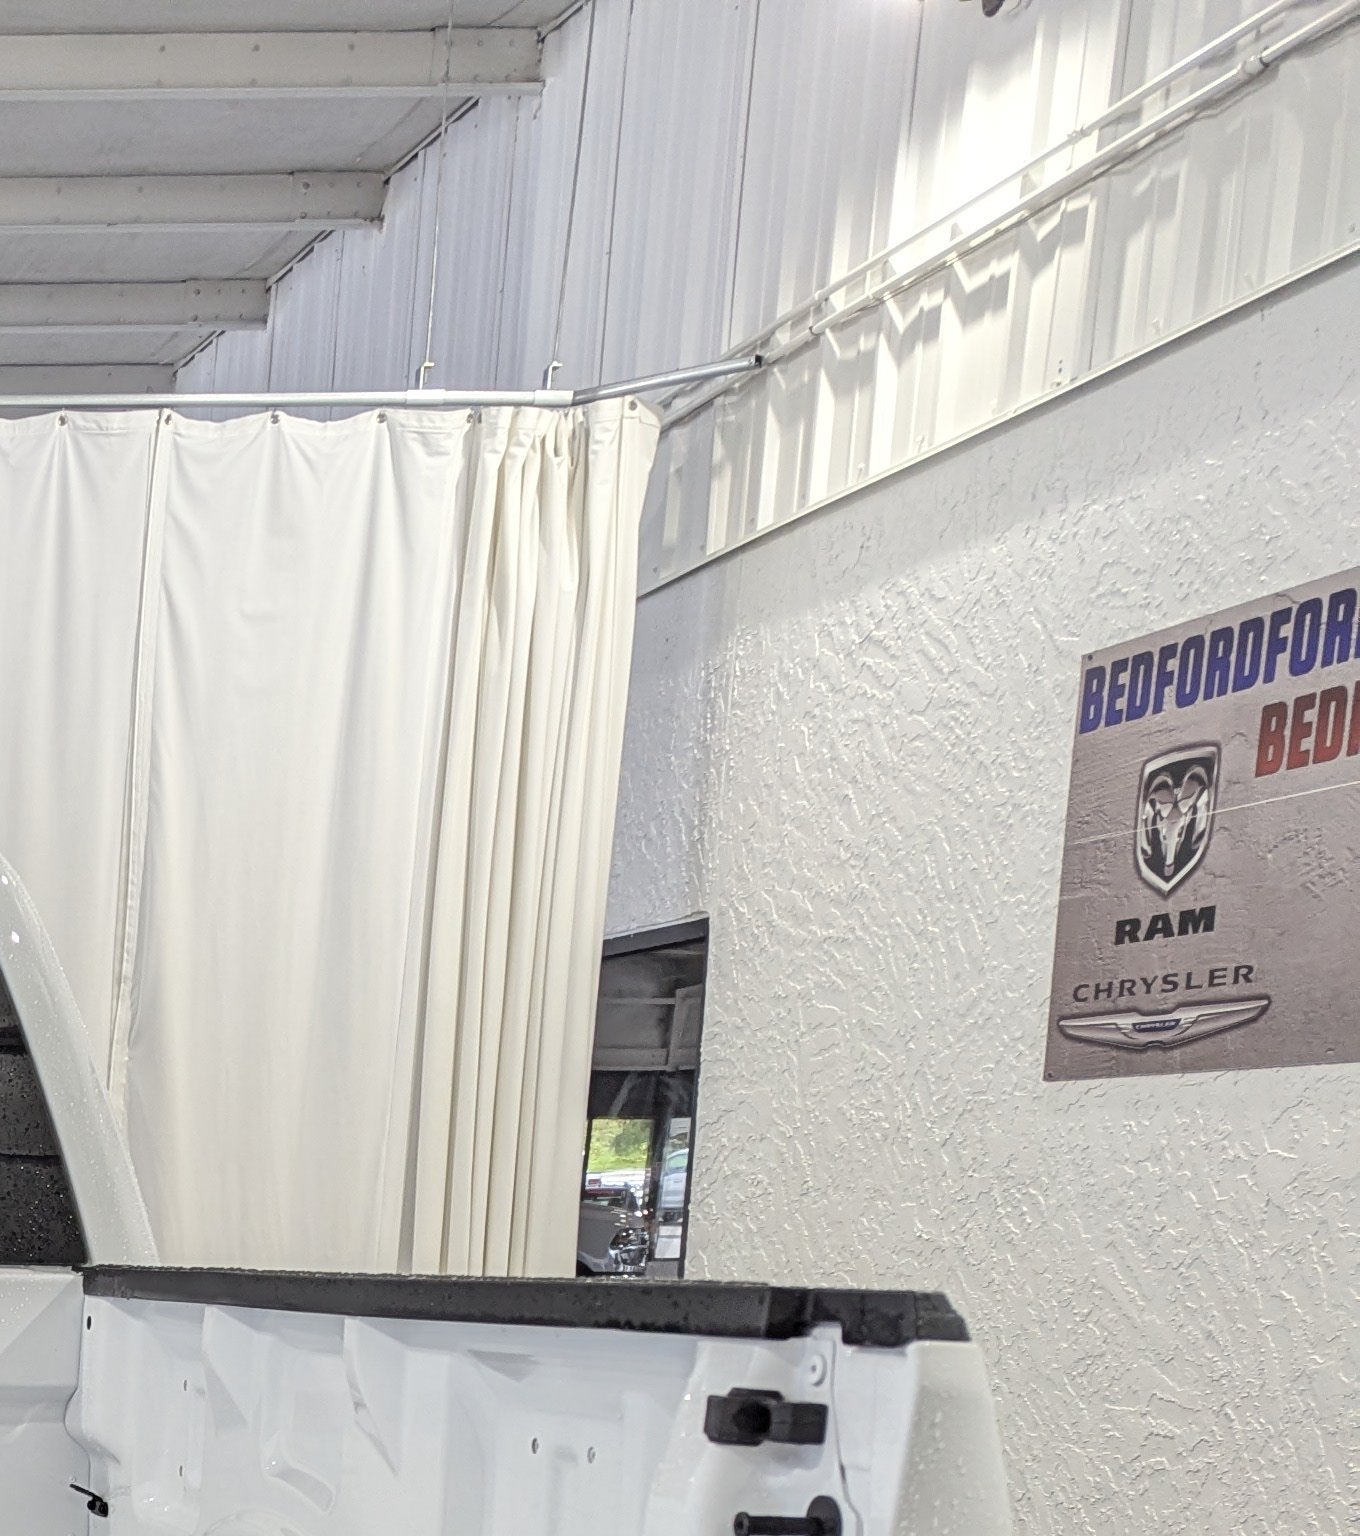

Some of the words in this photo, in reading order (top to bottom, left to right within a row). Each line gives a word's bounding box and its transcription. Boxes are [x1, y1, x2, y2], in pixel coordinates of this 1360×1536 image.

[1080, 588, 1360, 735] BEDFORDFOR
[1114, 905, 1216, 946] RAM
[1072, 964, 1254, 1003] CHRYSLER
